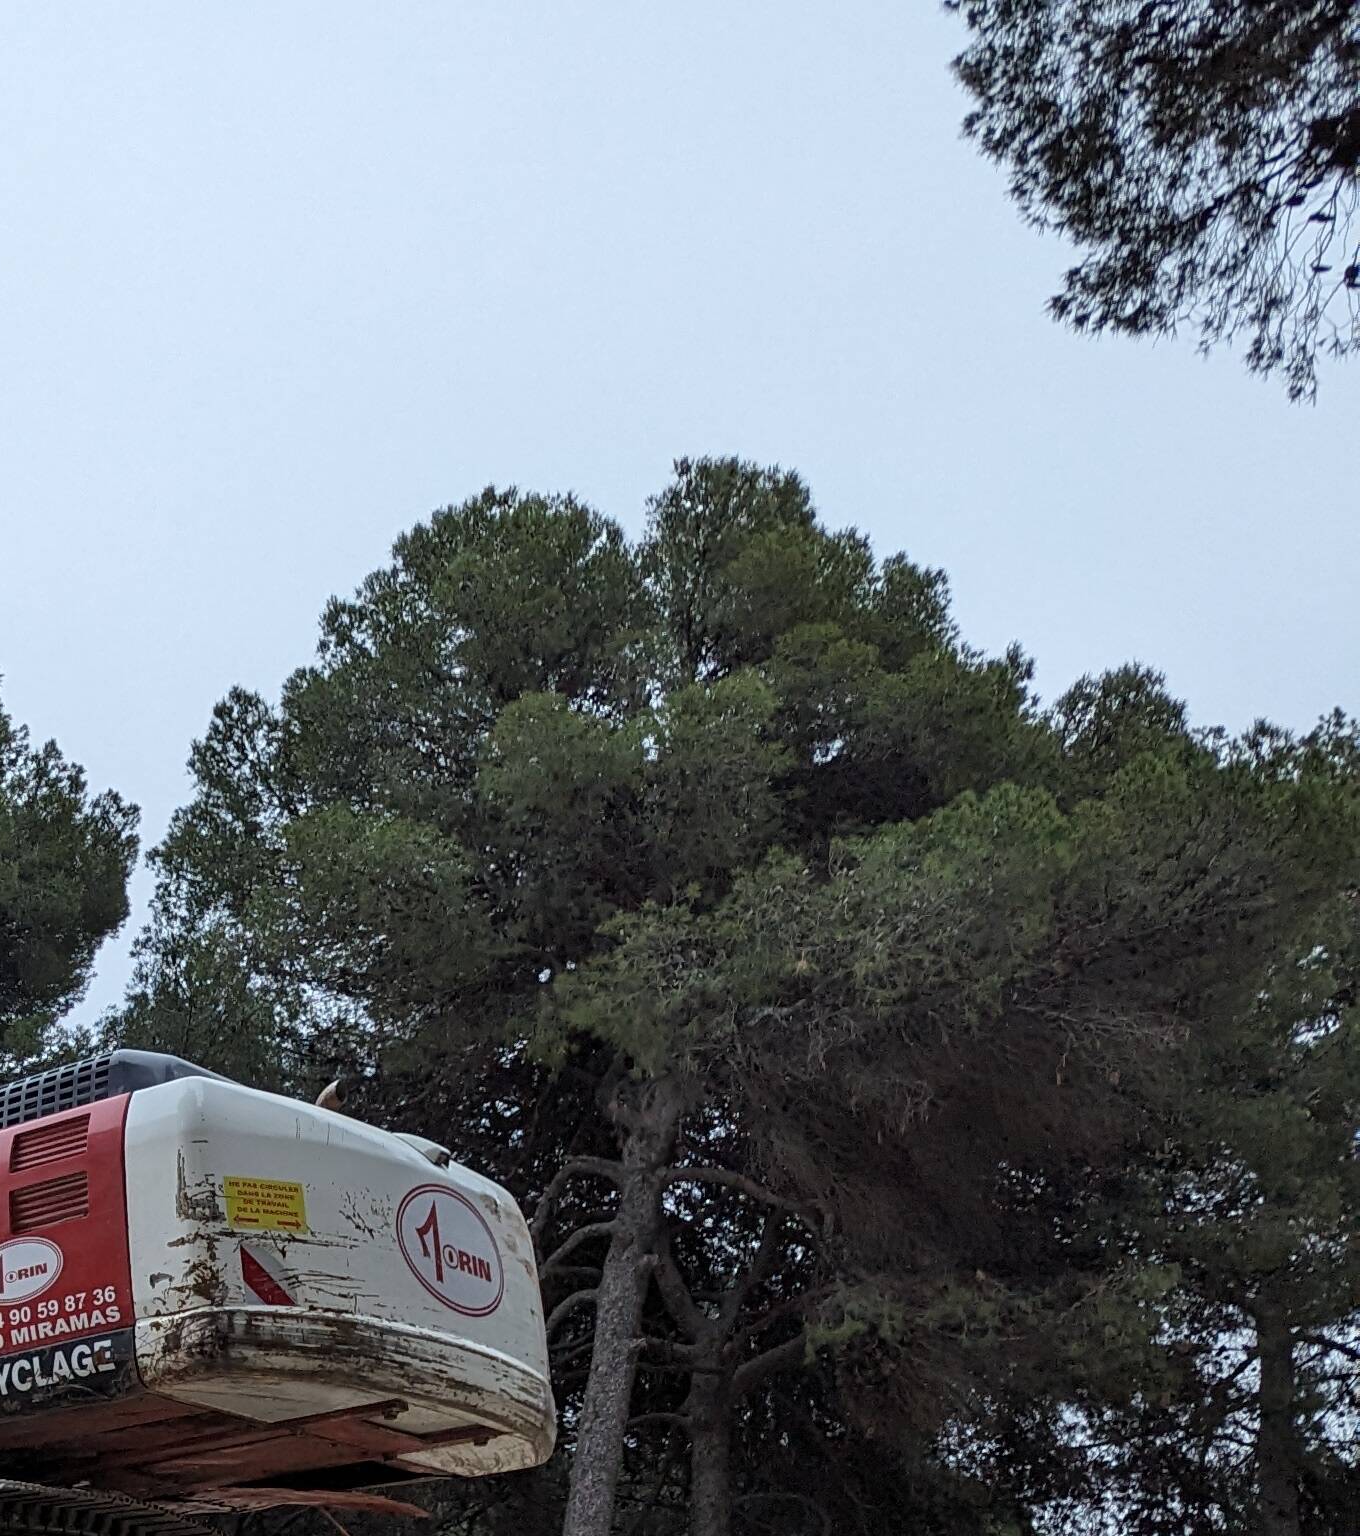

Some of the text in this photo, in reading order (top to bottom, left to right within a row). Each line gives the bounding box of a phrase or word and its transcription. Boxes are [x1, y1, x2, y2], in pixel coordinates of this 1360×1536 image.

[9, 1306, 31, 1326] 90
[37, 1299, 59, 1320] 59
[64, 1292, 87, 1313] 87
[93, 1286, 116, 1306] 36
[10, 1305, 121, 1346] MIRAMAS
